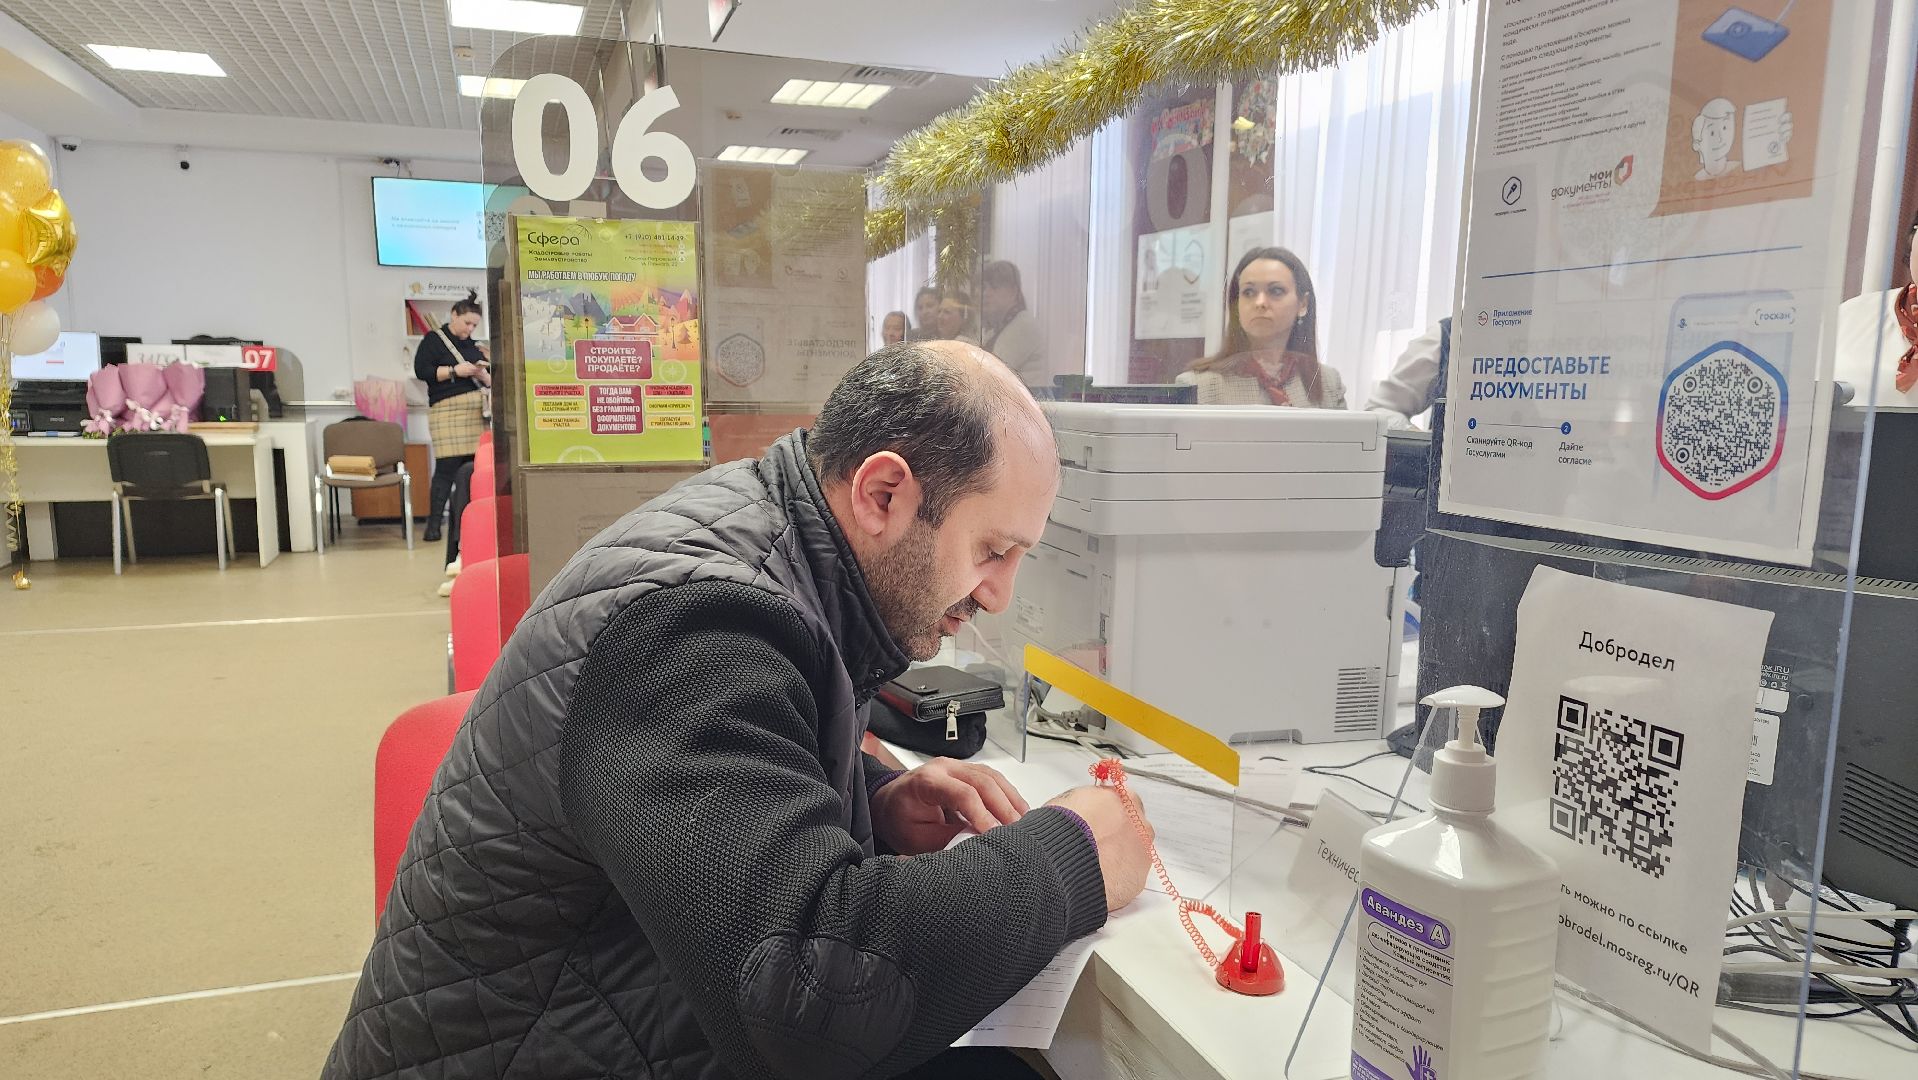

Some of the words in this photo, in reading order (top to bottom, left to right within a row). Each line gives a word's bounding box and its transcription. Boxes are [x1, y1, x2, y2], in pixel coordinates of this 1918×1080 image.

[511, 73, 697, 210] 06
[1589, 169, 1613, 181] мои
[1551, 178, 1612, 200] документы
[527, 231, 580, 248] Сфера
[528, 270, 541, 279] МЫ
[542, 270, 577, 280] РАБОТАЕМ
[1493, 309, 1533, 318] Приложение
[1492, 318, 1521, 327] Госуслуги
[590, 347, 636, 355] СТРОИТЕ?
[244, 349, 273, 368] 07
[585, 355, 642, 364] ПОКУПАЕТЕ?
[1472, 356, 1611, 377] ПРЕДОСТАВЬТЕ
[600, 387, 618, 395] ТОГДА
[619, 387, 632, 395] ВАМ
[1470, 382, 1587, 401] ДОКУМЕНТЫ
[596, 414, 637, 423] ОФОРМЛЕНИЯ
[1466, 435, 1506, 447] Сканируйте
[1506, 438, 1533, 449] QR-код
[1559, 441, 1584, 452] Дайте
[1466, 448, 1506, 458] Госуслугами
[1558, 456, 1592, 465] согласие
[1578, 630, 1675, 671] Добродел
[1367, 895, 1425, 934] Авандез
[1430, 923, 1447, 947] А
[1574, 890, 1615, 918] можно
[1619, 913, 1635, 928] по
[1638, 923, 1688, 954] ссылке
